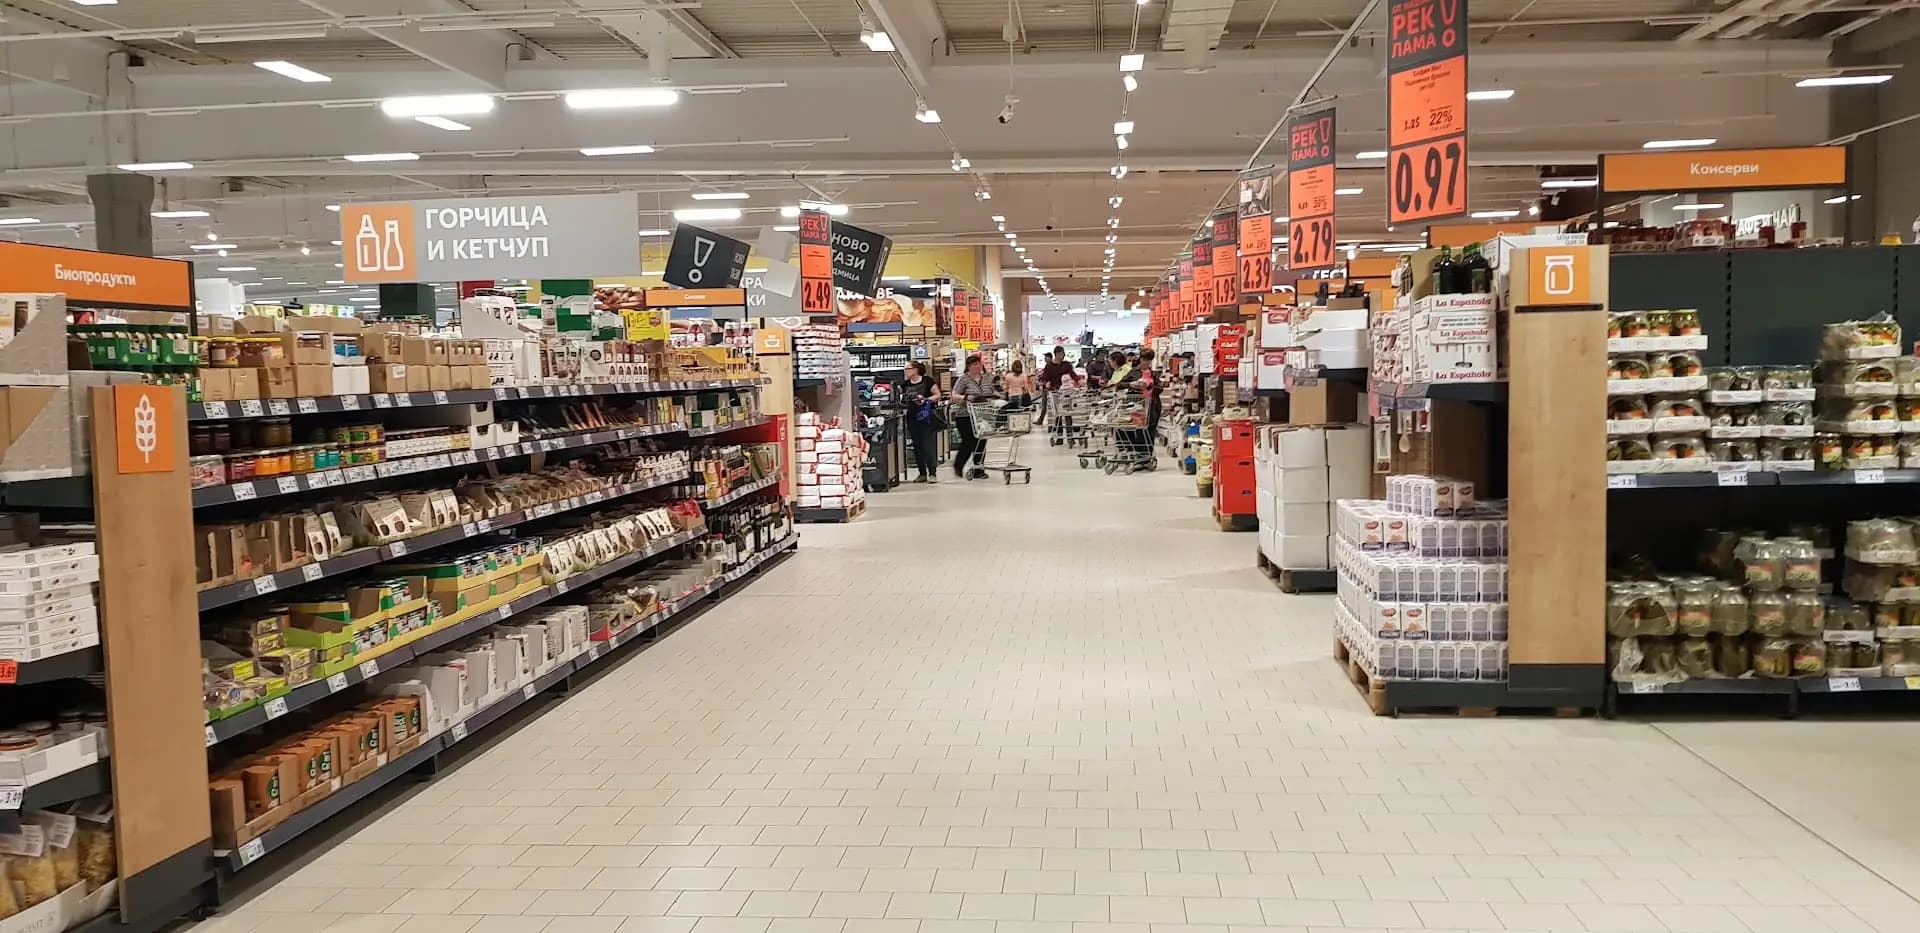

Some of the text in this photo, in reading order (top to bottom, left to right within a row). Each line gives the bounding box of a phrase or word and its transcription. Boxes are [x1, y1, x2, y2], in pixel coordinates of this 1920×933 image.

[1392, 4, 1435, 39] РЕК
[1392, 33, 1436, 58] ЛАМА
[1429, 110, 1453, 126] 22%
[1292, 128, 1317, 149] РЕК
[1396, 142, 1461, 214] 0.97
[1690, 163, 1760, 176] Консерви
[425, 206, 549, 230] ГОРЧИЦА
[801, 219, 819, 231] РЕК
[1773, 204, 1796, 228] ЧАЙ
[427, 237, 549, 260] И КЕТЧУП
[832, 233, 869, 253] НОВО
[1293, 220, 1332, 264] 2.79
[55, 264, 136, 288] Биопродукти
[1243, 257, 1270, 289] 2.39
[805, 282, 830, 309] 2.49
[1196, 292, 1212, 313] 1.39
[1216, 278, 1236, 303] 1.95
